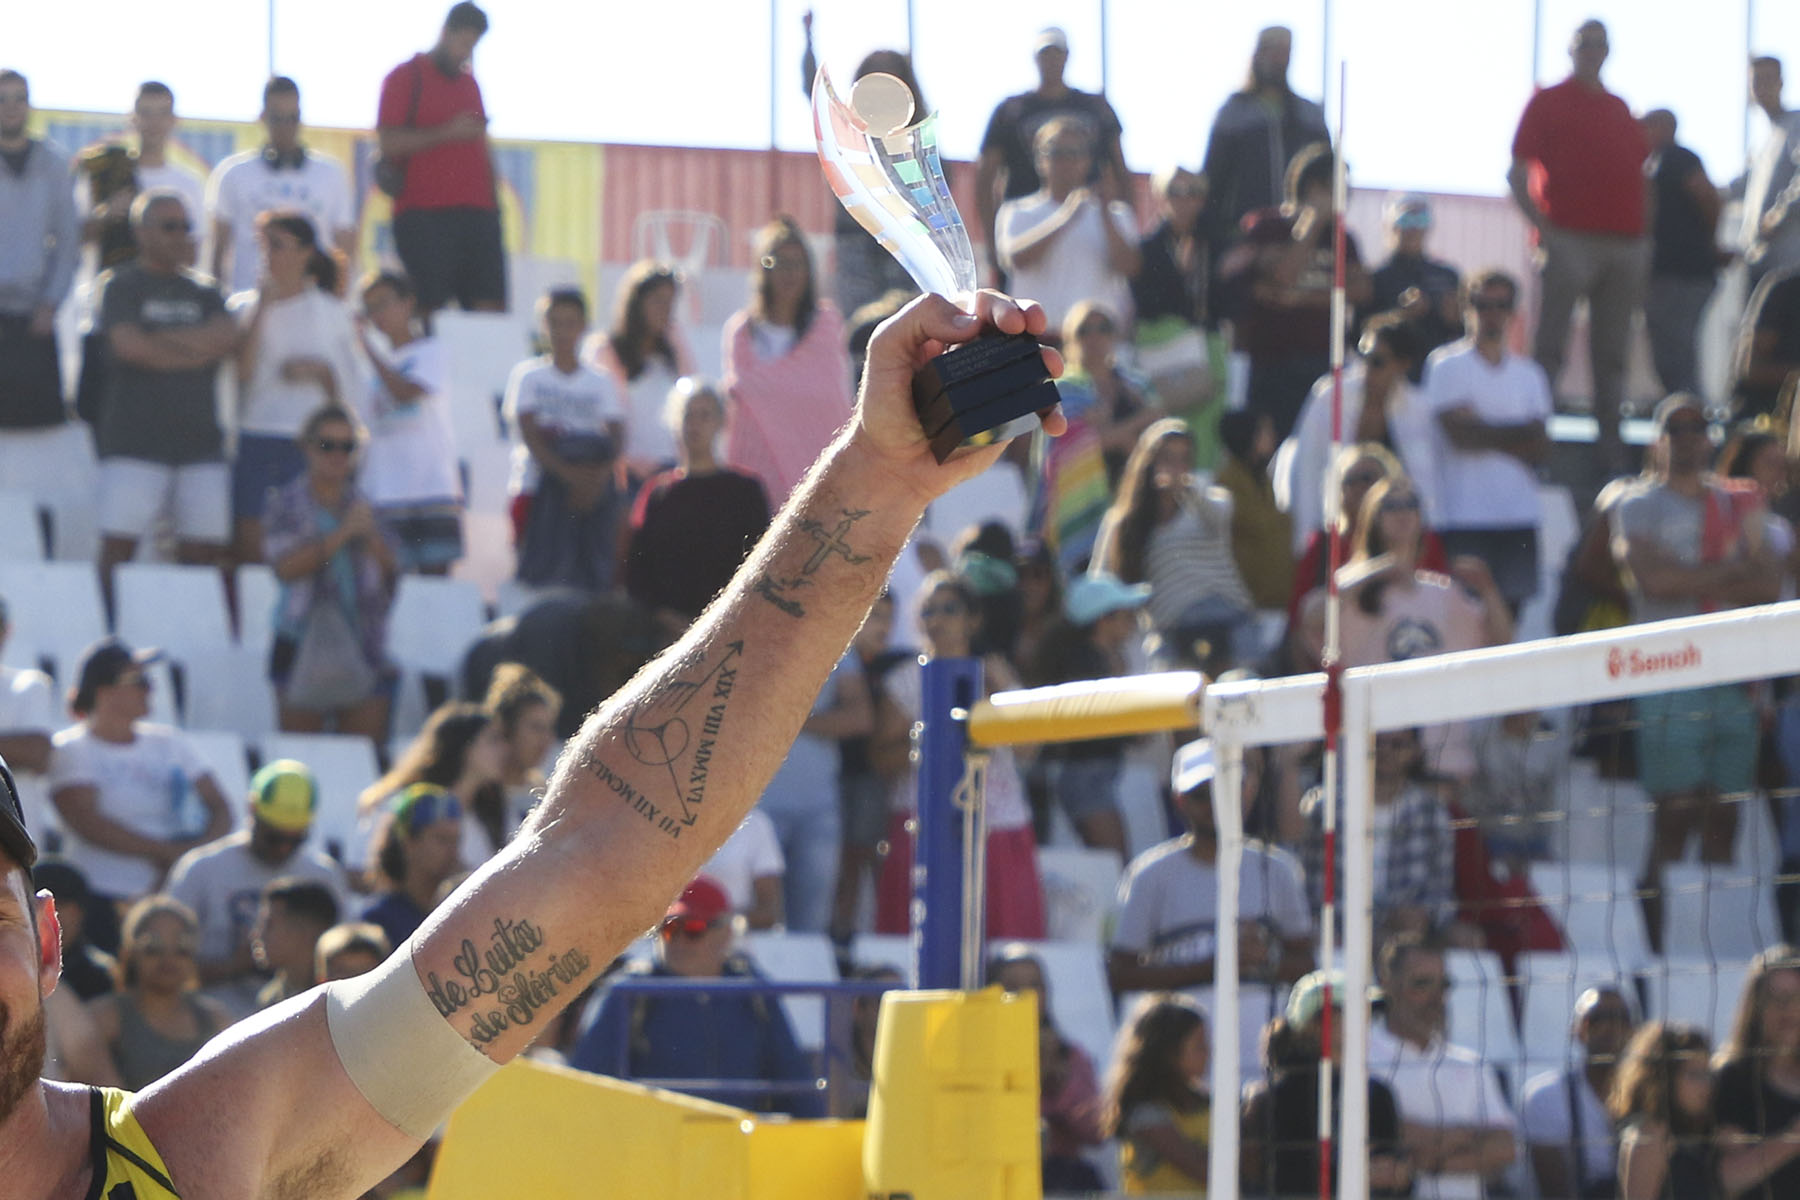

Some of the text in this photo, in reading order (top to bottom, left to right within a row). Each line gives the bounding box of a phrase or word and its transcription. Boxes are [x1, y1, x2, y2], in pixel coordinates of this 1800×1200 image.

[1629, 642, 1702, 676] Senoh
[428, 917, 543, 1018] de Luta
[470, 1011, 509, 1043] de
